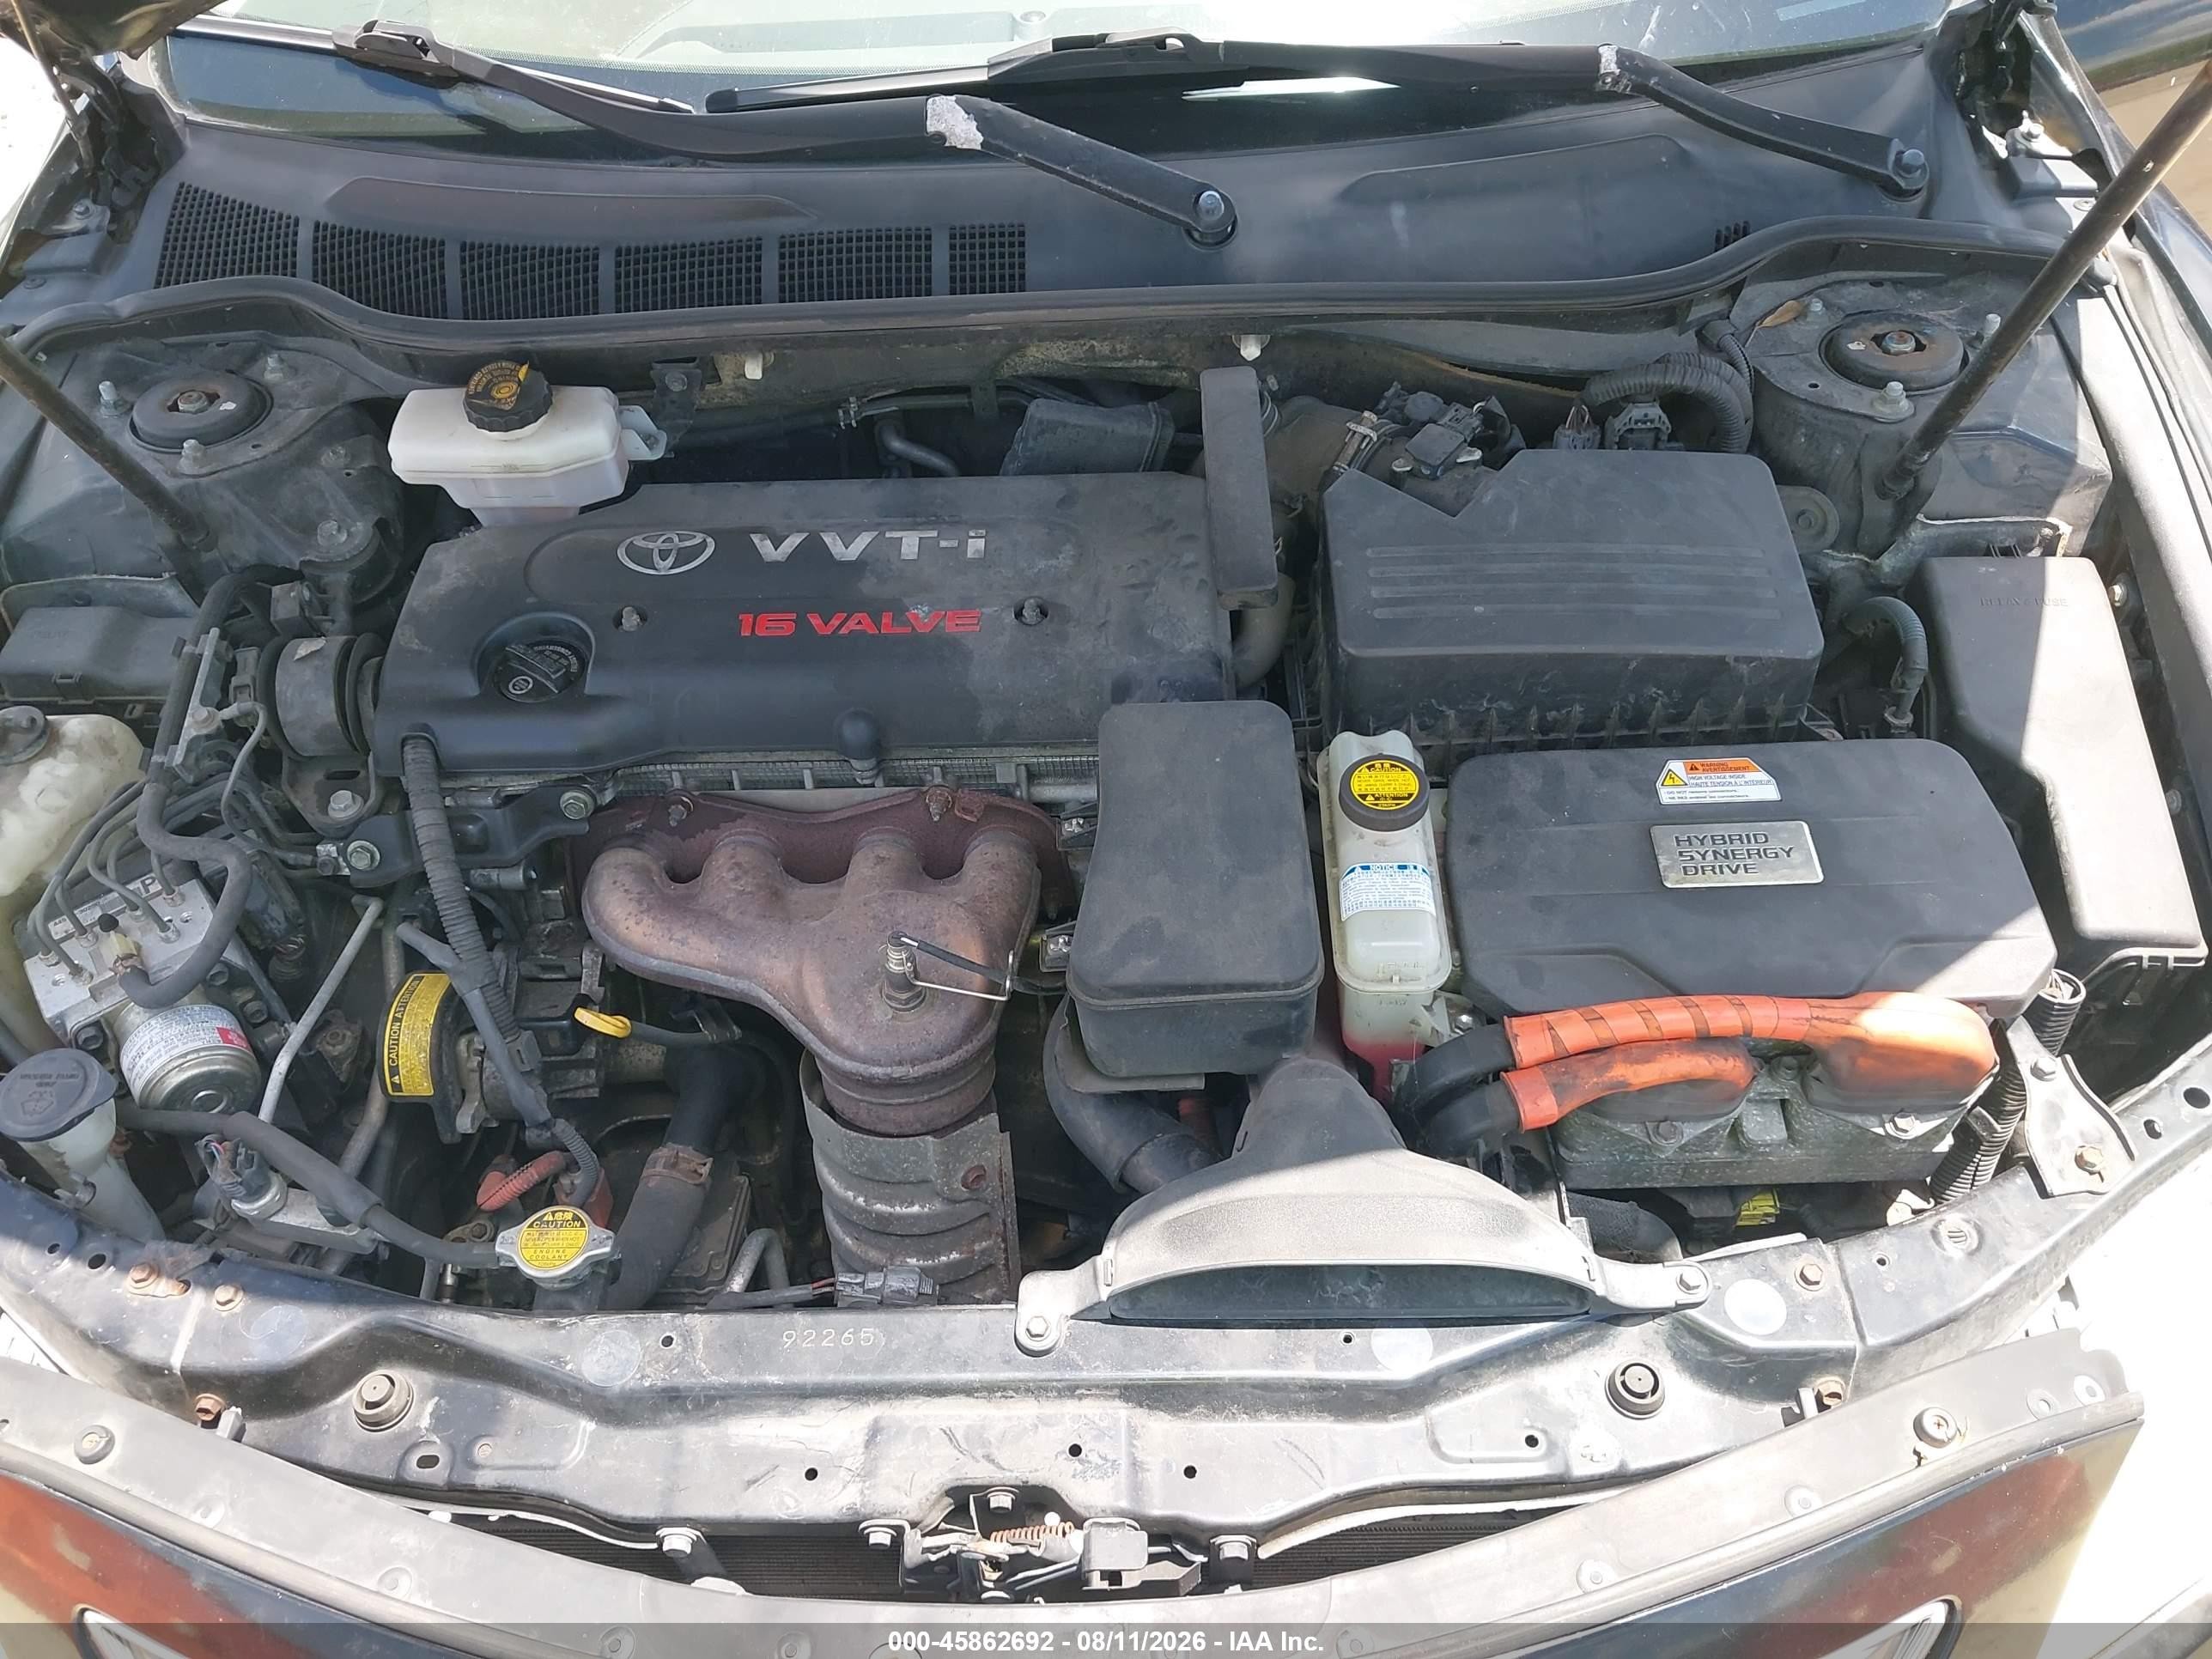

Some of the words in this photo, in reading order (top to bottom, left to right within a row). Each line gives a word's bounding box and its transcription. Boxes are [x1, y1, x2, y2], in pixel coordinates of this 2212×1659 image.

[749, 529, 987, 562] VVT-i
[739, 612, 797, 637] 16
[806, 610, 981, 635] VALVE
[1674, 832, 1769, 847] HYBRID
[1677, 847, 1795, 862] SYNERGY
[1680, 863, 1759, 876] DRIVE
[394, 980, 421, 1018] ATTENTION
[389, 1022, 401, 1066] CAUTION
[532, 1220, 581, 1229] CAUTION
[780, 1326, 860, 1345] 92265
